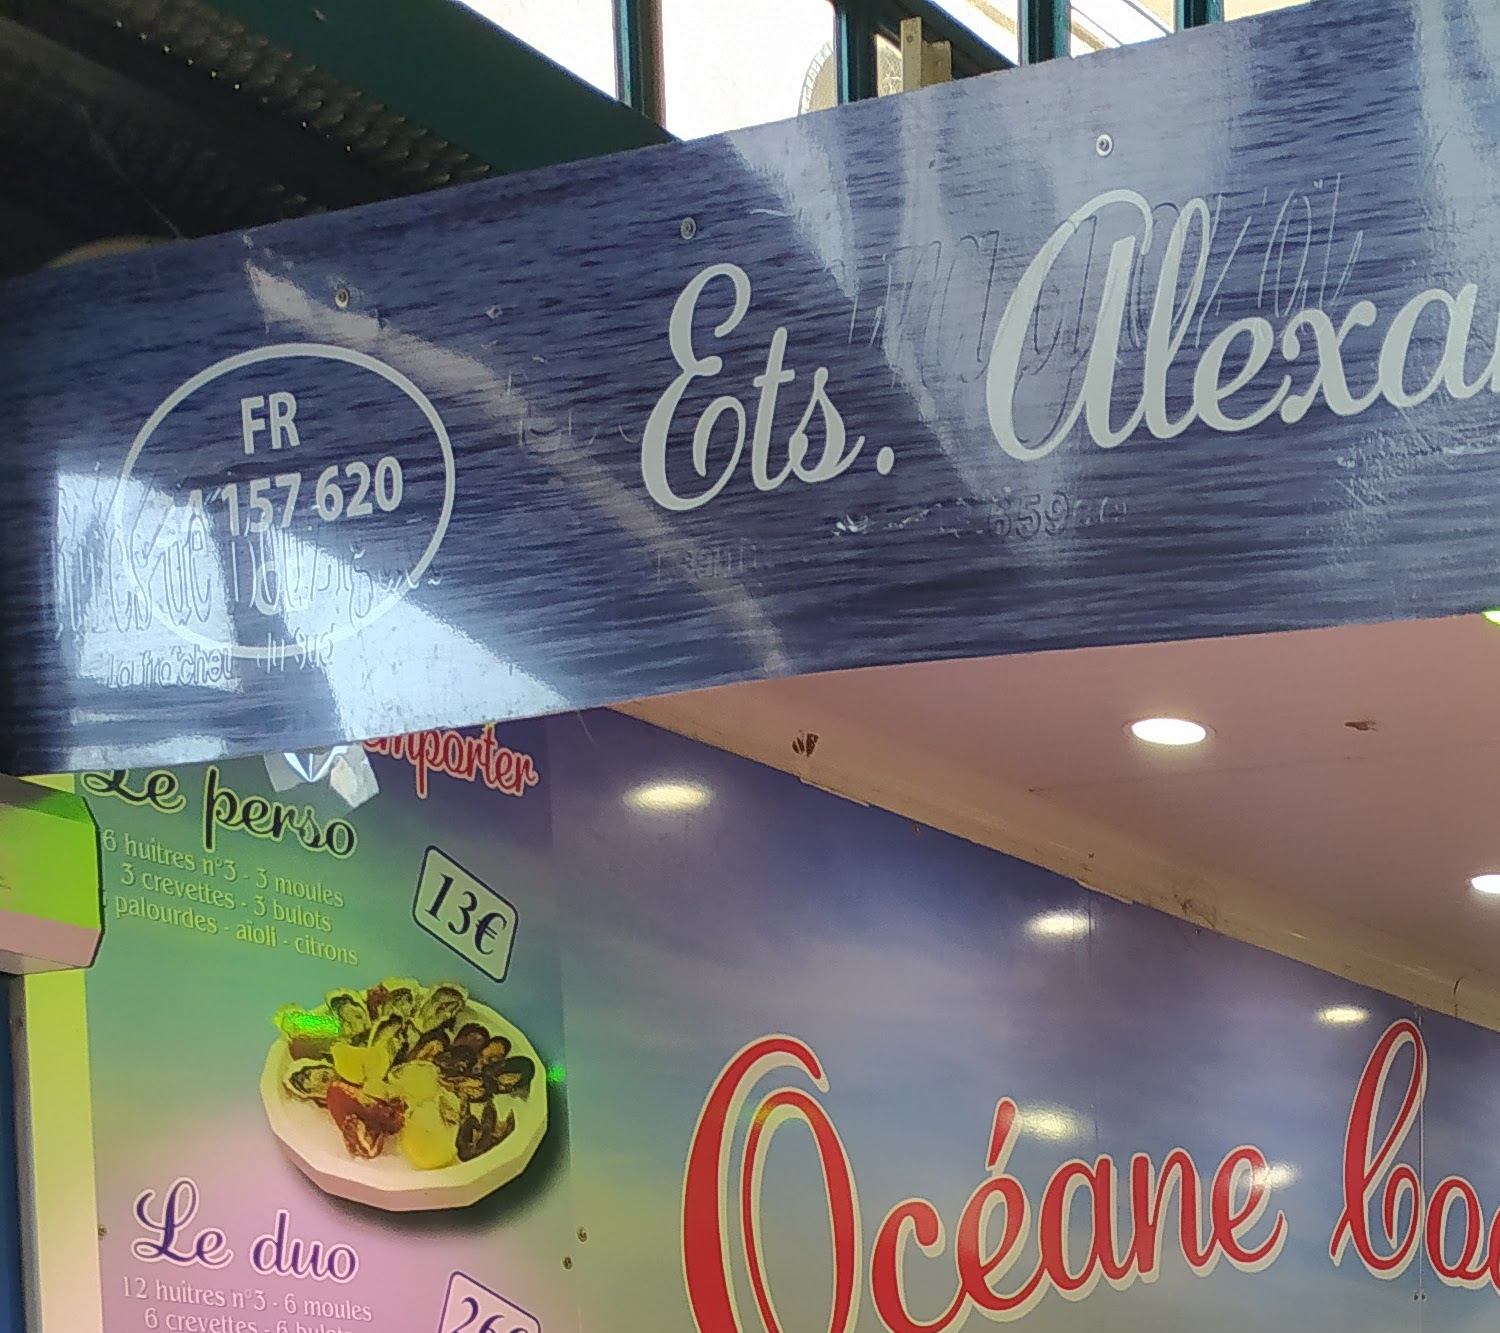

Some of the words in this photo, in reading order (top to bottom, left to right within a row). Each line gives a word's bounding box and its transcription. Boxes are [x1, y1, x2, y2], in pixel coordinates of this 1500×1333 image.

[241, 391, 300, 455] FR
[641, 262, 895, 511] Ets.
[220, 471, 302, 537] 157
[315, 456, 404, 521] 620
[200, 765, 358, 858] perso
[103, 829, 117, 851] 6
[125, 832, 196, 872] huîtres
[256, 867, 268, 889] 3
[275, 876, 344, 908] moules
[122, 862, 136, 885] 3
[142, 872, 236, 911] crevettes
[254, 894, 267, 916] 3
[274, 902, 333, 933] bulots
[116, 895, 218, 934] palourdes
[294, 934, 359, 966] citrons
[423, 873, 505, 957] 13€
[129, 1176, 234, 1269] Le
[249, 1208, 360, 1284] duo
[123, 1276, 148, 1300] 12
[155, 1280, 226, 1308] huîtres
[284, 1292, 297, 1315] 6
[303, 1297, 372, 1322] moules
[144, 1308, 159, 1329] 6
